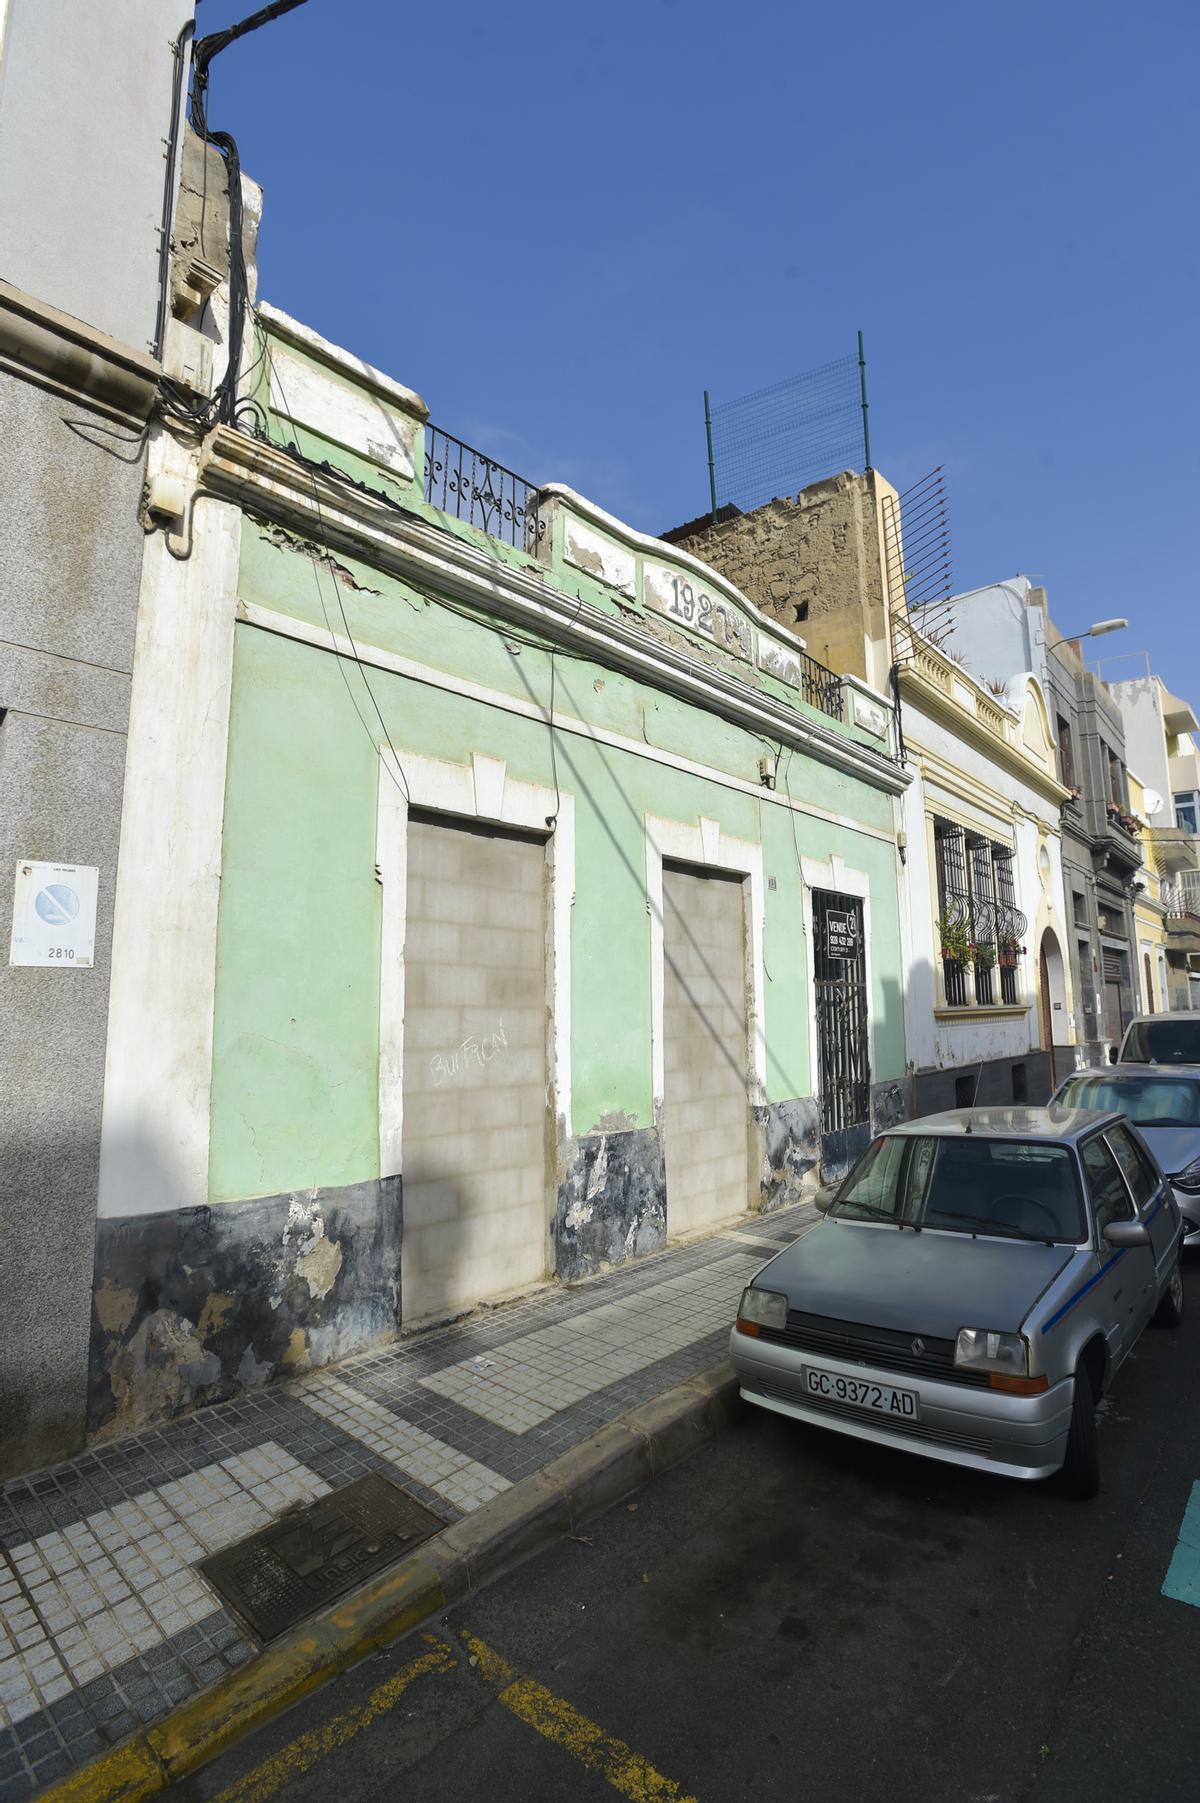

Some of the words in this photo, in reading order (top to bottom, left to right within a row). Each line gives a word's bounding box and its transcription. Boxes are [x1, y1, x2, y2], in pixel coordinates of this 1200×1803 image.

[829, 921, 847, 934] VENDE
[48, 947, 75, 960] 2810
[302, 1544, 381, 1592] Unelco
